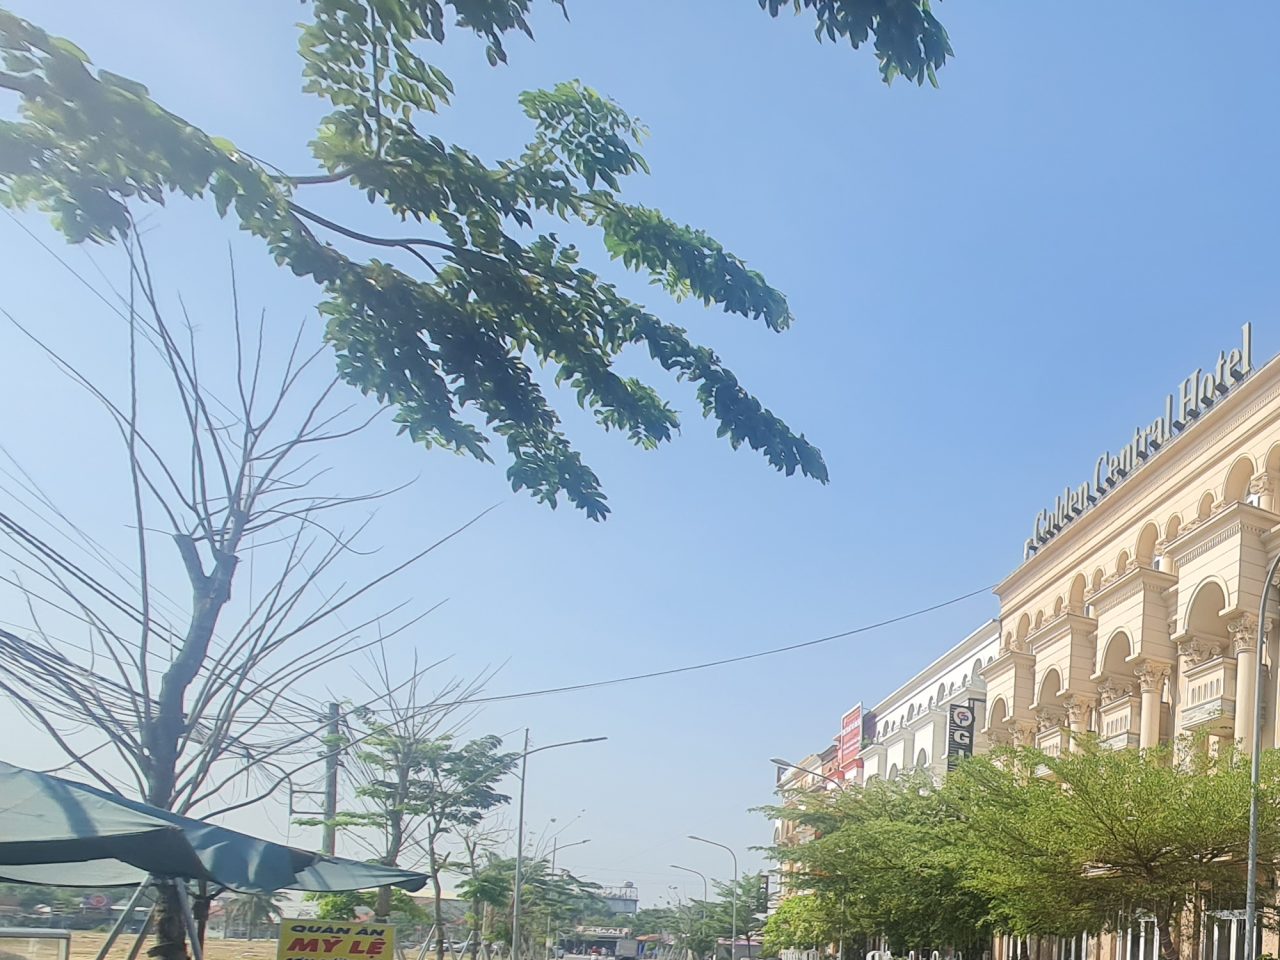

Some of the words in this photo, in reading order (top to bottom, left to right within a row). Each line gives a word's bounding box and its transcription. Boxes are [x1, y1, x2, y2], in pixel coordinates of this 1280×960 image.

[1033, 480, 1091, 543] Golden
[1094, 394, 1174, 494] Central
[1178, 321, 1252, 424] Hotel
[287, 936, 344, 953] MỸ
[348, 938, 387, 959] LỆ
